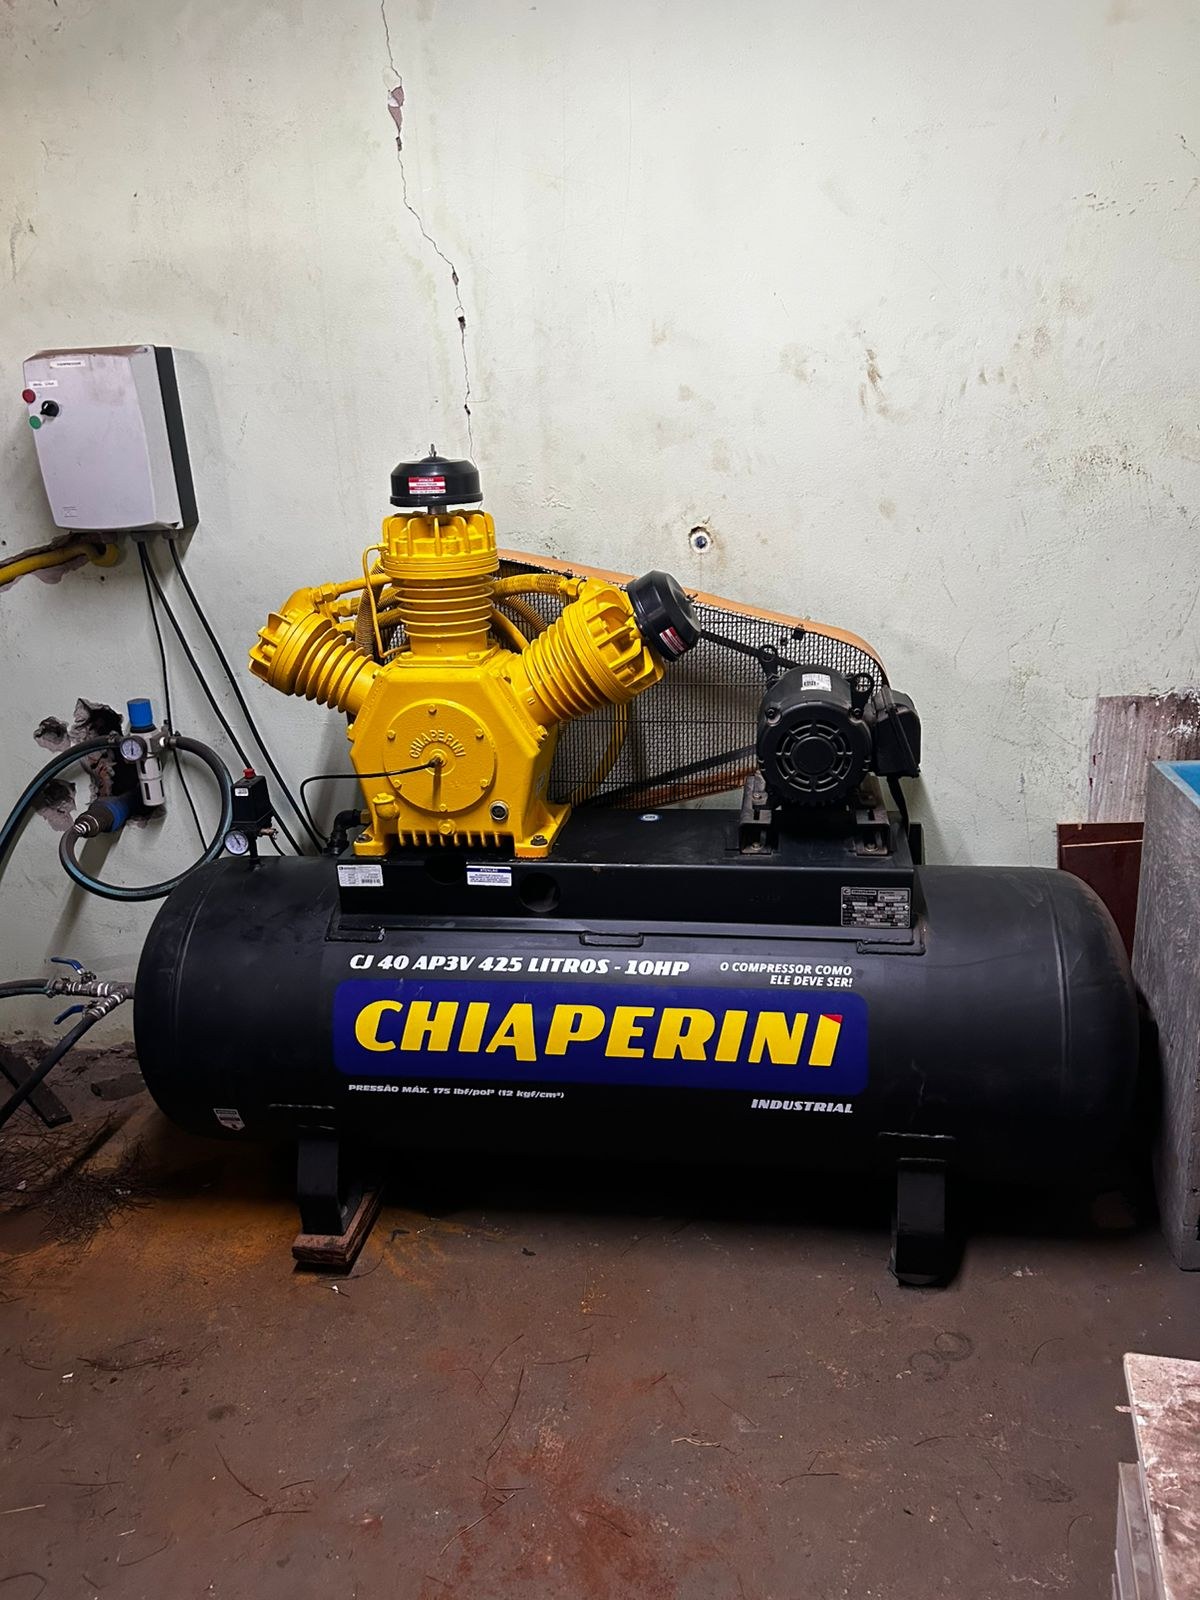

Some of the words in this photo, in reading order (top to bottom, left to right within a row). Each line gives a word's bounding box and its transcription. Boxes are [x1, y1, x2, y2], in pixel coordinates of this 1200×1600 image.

[408, 729, 467, 759] CHIAPERINI
[349, 954, 374, 970] CJ
[377, 954, 410, 970] 40
[411, 955, 476, 971] AP3V
[478, 956, 523, 972] 425
[527, 957, 609, 974] LITROS
[624, 959, 690, 976] 10HP
[719, 961, 729, 972] O
[732, 962, 812, 975] COMPRESSOR
[815, 964, 852, 976] COMO
[769, 974, 792, 985] ELE
[793, 975, 825, 987] DEVE
[826, 977, 853, 988] SER!
[354, 999, 843, 1067] CHIAPERINI
[348, 1084, 399, 1093] PRESSÃO
[402, 1085, 430, 1094] MÁX.
[433, 1087, 451, 1095] 175
[498, 1089, 513, 1097] (12
[750, 1098, 854, 1114] INDUSTRIAL
